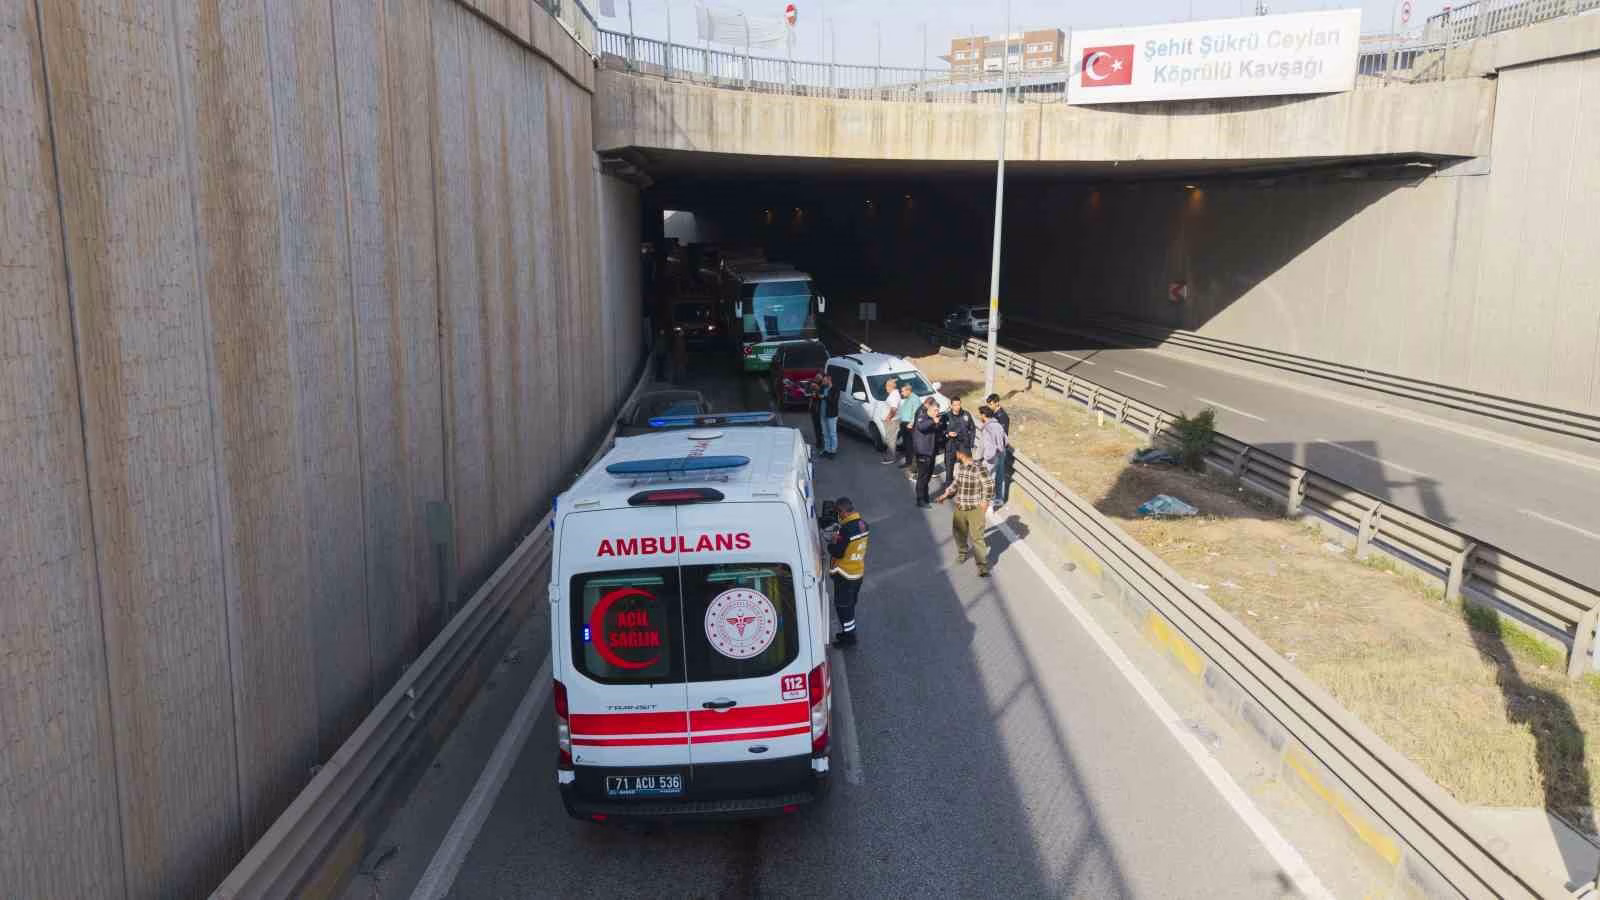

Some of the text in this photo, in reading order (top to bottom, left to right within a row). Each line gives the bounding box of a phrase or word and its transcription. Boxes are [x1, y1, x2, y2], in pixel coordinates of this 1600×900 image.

[1144, 27, 1341, 62] Şehit Şükrü Ceylan
[1153, 56, 1323, 86] Köprülü Kavşağı
[597, 532, 751, 557] AMBULANS
[784, 676, 803, 690] 112
[615, 776, 680, 790] 71 ACU 536
